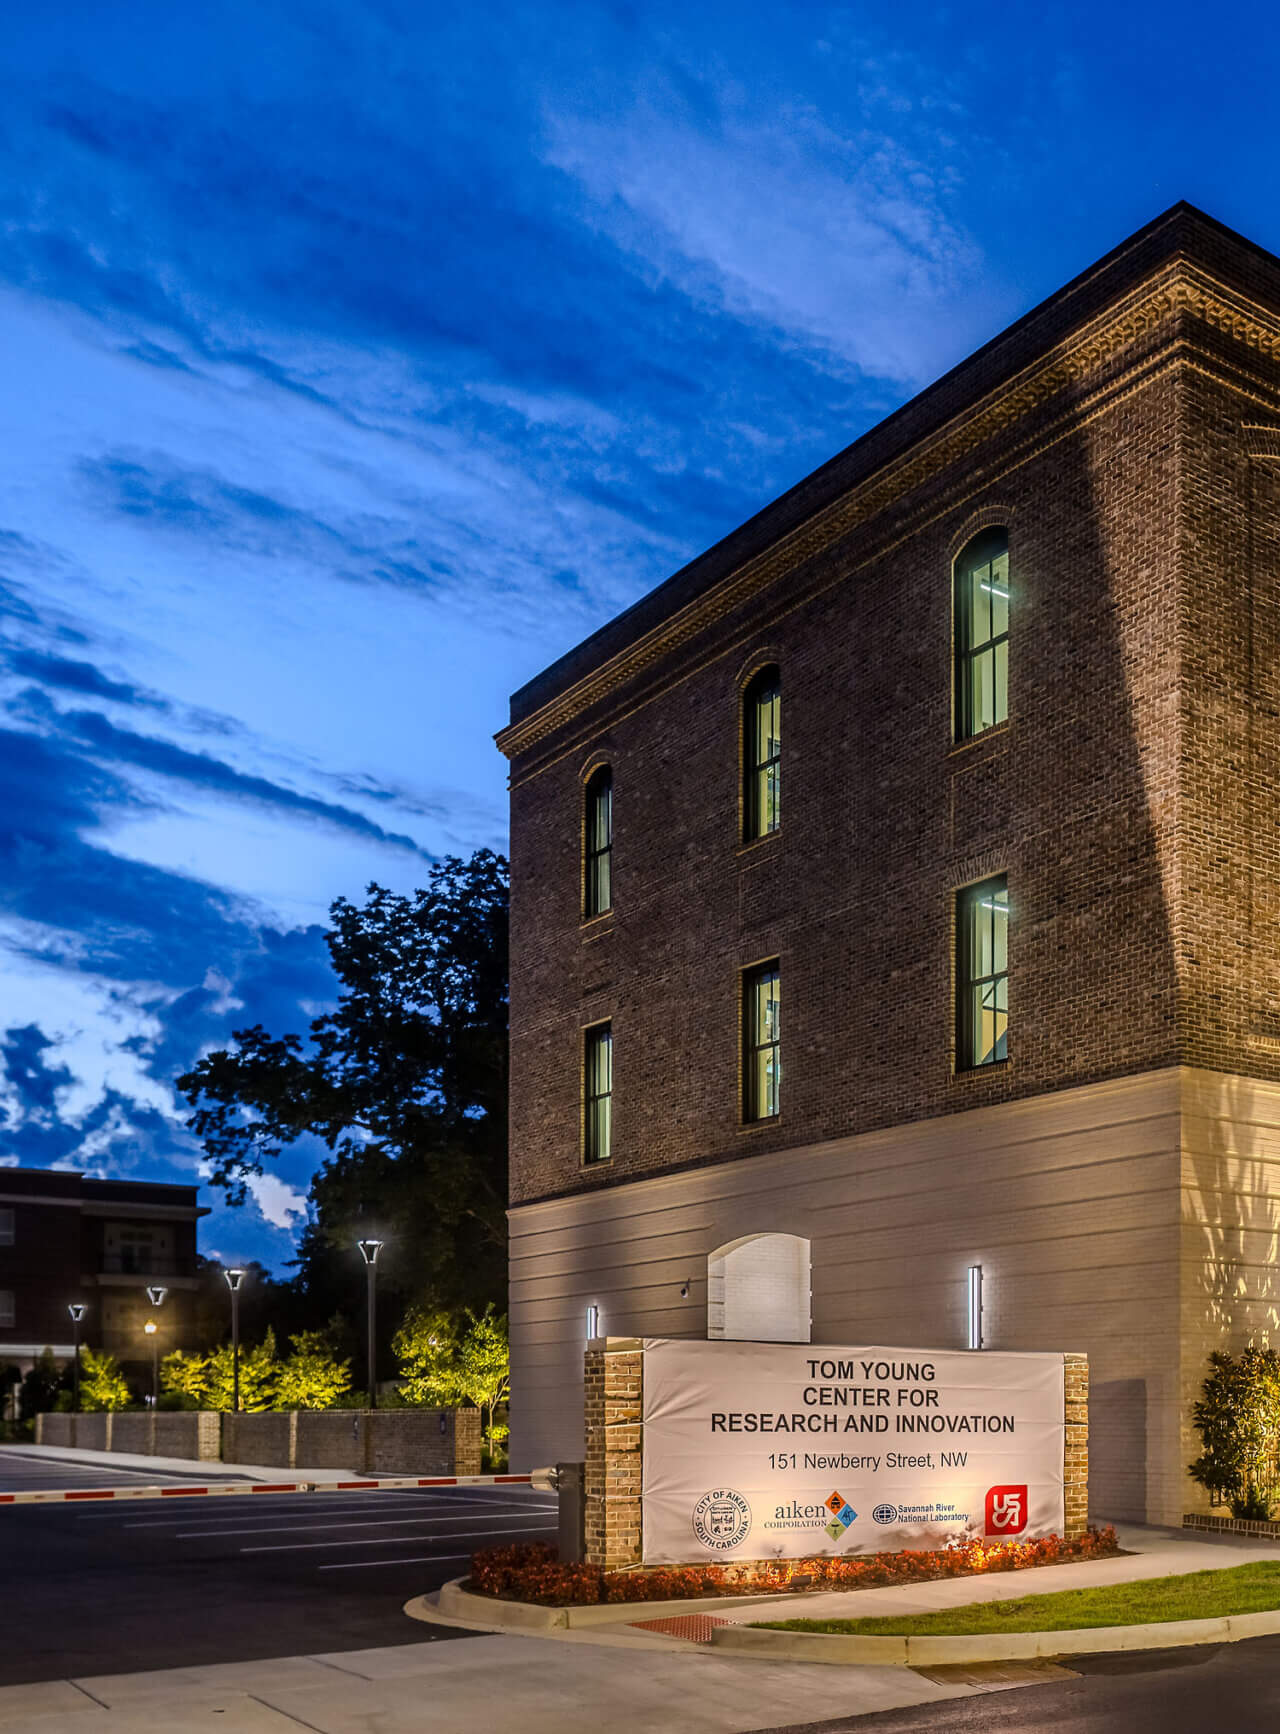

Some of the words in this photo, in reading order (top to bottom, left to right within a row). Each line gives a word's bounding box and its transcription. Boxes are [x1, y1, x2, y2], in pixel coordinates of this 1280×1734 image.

[807, 1360, 854, 1379] TOM
[860, 1362, 935, 1381] YOUNG
[803, 1387, 890, 1406] CENTER
[897, 1389, 939, 1407] FOR
[711, 1413, 837, 1432] RESEARCH
[844, 1415, 889, 1432] AND
[896, 1415, 1014, 1433] INNOVATION
[768, 1453, 797, 1469] 151
[804, 1453, 881, 1472] Newberry
[886, 1452, 935, 1470] Street,
[941, 1452, 968, 1467] NW
[697, 1495, 711, 1514] CITY
[712, 1491, 725, 1499] OF
[726, 1491, 748, 1513] AIKEN
[775, 1499, 826, 1519] aiken
[898, 1504, 934, 1513] Savannah
[935, 1503, 955, 1512] River
[763, 1519, 828, 1528] CORPORATION
[898, 1514, 929, 1523] National
[930, 1512, 969, 1522] Laboratory
[695, 1521, 716, 1547] SOUTH
[716, 1520, 749, 1549] CAROLINA
